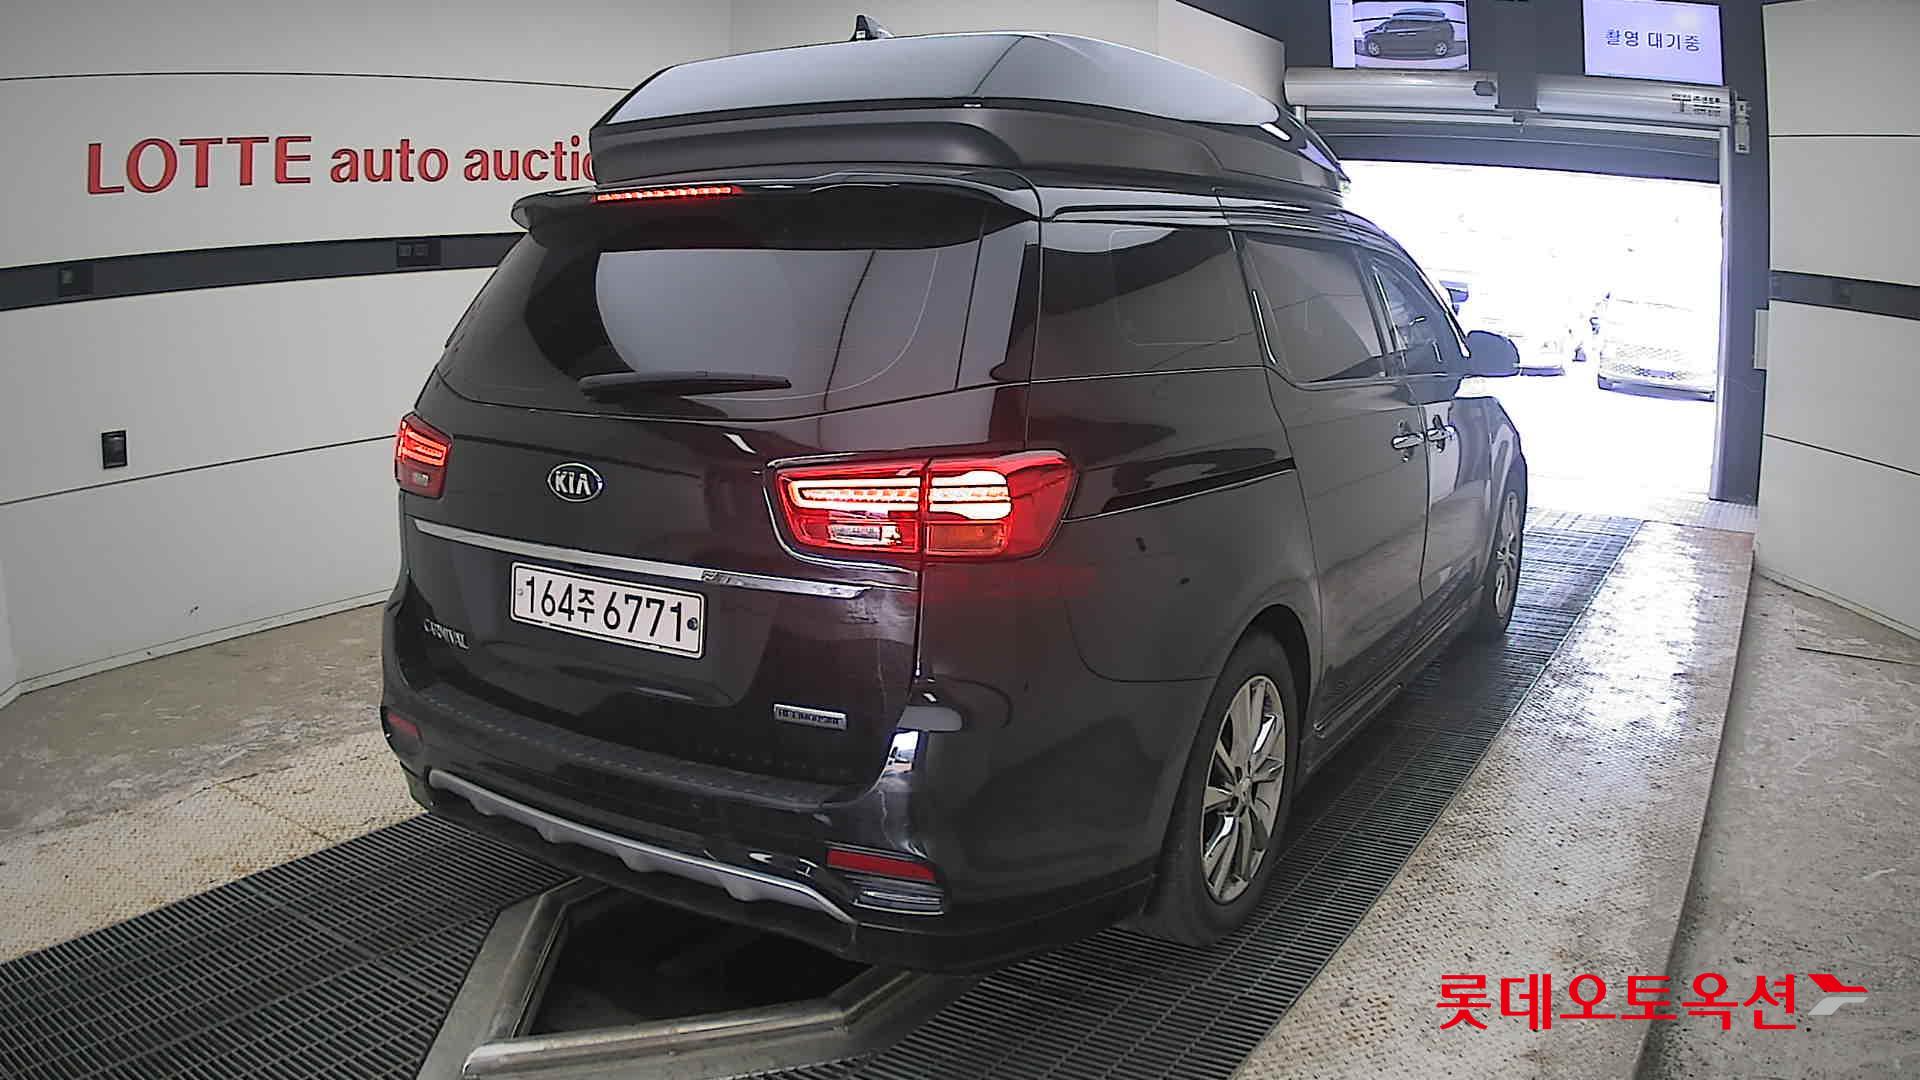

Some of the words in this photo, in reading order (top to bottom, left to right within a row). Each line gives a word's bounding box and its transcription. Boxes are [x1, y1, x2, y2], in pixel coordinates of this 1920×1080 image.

[1606, 28, 1640, 48] 촬영
[1647, 32, 1701, 52] 대기중
[86, 135, 313, 196] LOTTE
[330, 138, 450, 184] auto
[554, 470, 592, 496] KIA
[525, 575, 596, 624] 164주
[603, 591, 683, 642] 6771
